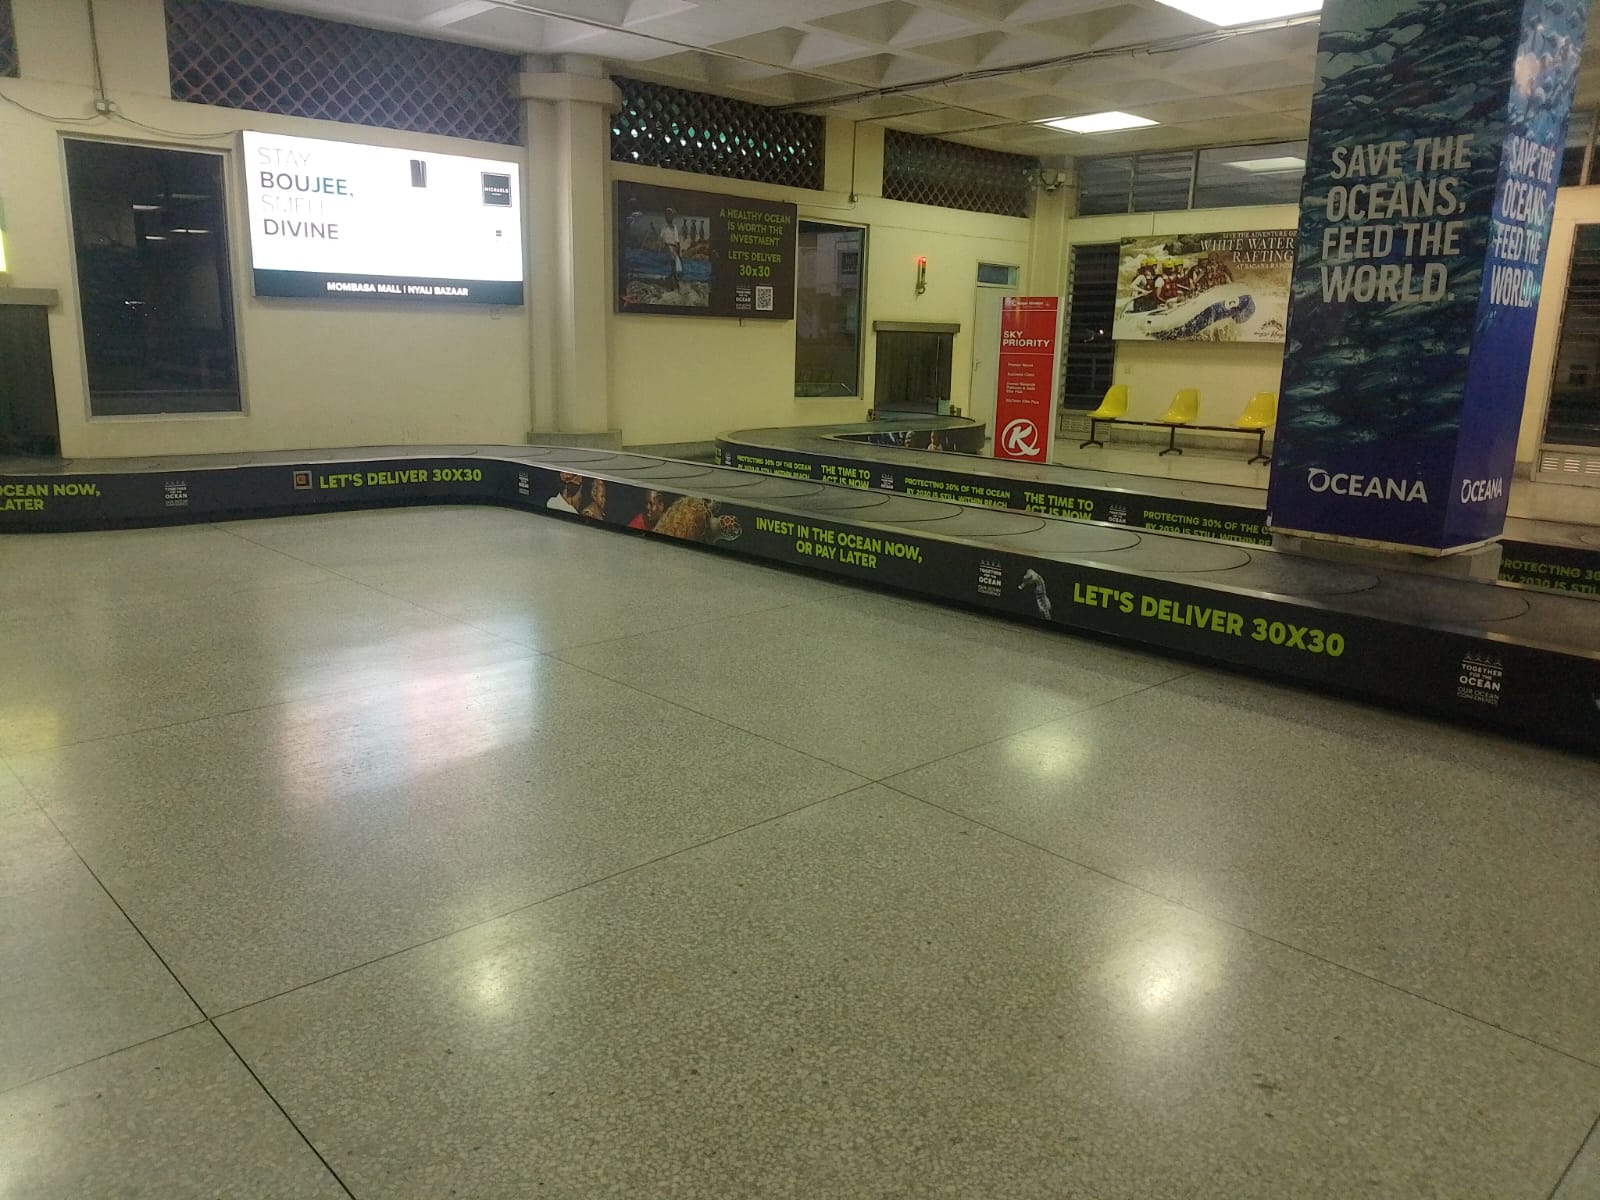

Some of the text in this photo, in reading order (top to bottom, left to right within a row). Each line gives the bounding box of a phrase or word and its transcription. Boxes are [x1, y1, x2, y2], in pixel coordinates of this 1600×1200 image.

[258, 147, 311, 167] STAY
[1330, 134, 1474, 179] SAVE THE
[1509, 136, 1556, 183] SAVE THE
[260, 170, 354, 198] BOUJEE,
[1326, 177, 1466, 222] OCEANS,
[719, 208, 791, 224] A HEALTHY OCEAN
[263, 218, 339, 240] DIVINE
[727, 221, 784, 235] IS WORTH THE
[730, 234, 780, 247] INVESTMENT
[1200, 237, 1295, 251] WHITE WATER
[1321, 220, 1464, 260] FEED THE
[1495, 223, 1543, 265] FEED THE
[728, 250, 782, 263] LET'S DELIVER
[1233, 249, 1294, 263] RAFTING
[739, 265, 770, 277] 30x30
[327, 281, 469, 296] MOMBASA MALL NYALI BAZAAR
[1320, 262, 1455, 303] WORLD.
[1003, 330, 1023, 338] SKY
[1003, 339, 1050, 348] PRIORITY
[320, 468, 482, 489] LET'S DELIVER 30X30
[821, 464, 871, 480] THE TIME TO
[53, 483, 101, 497] NOW,
[839, 477, 847, 485] IS
[848, 479, 870, 489] NOW
[904, 477, 944, 490] PROTECTING
[960, 485, 970, 493] OF
[971, 486, 984, 495] THE
[985, 488, 1010, 499] OCEAN
[1308, 467, 1428, 503] OCEANA
[1461, 477, 1502, 504] OCEANA
[1024, 491, 1094, 511] THE TIME TO
[1049, 507, 1059, 517] IS
[1062, 509, 1092, 521] NOW
[1144, 510, 1200, 525] PROTECTING
[1202, 518, 1222, 529] 30%
[1224, 521, 1238, 531] OF
[1240, 523, 1259, 535] THE
[756, 517, 923, 564] INVEST IN THE OCEAN NOW,
[1219, 533, 1256, 545] WITHIN
[795, 540, 876, 568] OR PAY LATER
[978, 576, 1002, 587] OCEAN
[1073, 582, 1345, 657] LET'S DELIVER 30X30
[1462, 663, 1503, 677] TOGETHER
[1459, 675, 1501, 692] OCEAN
